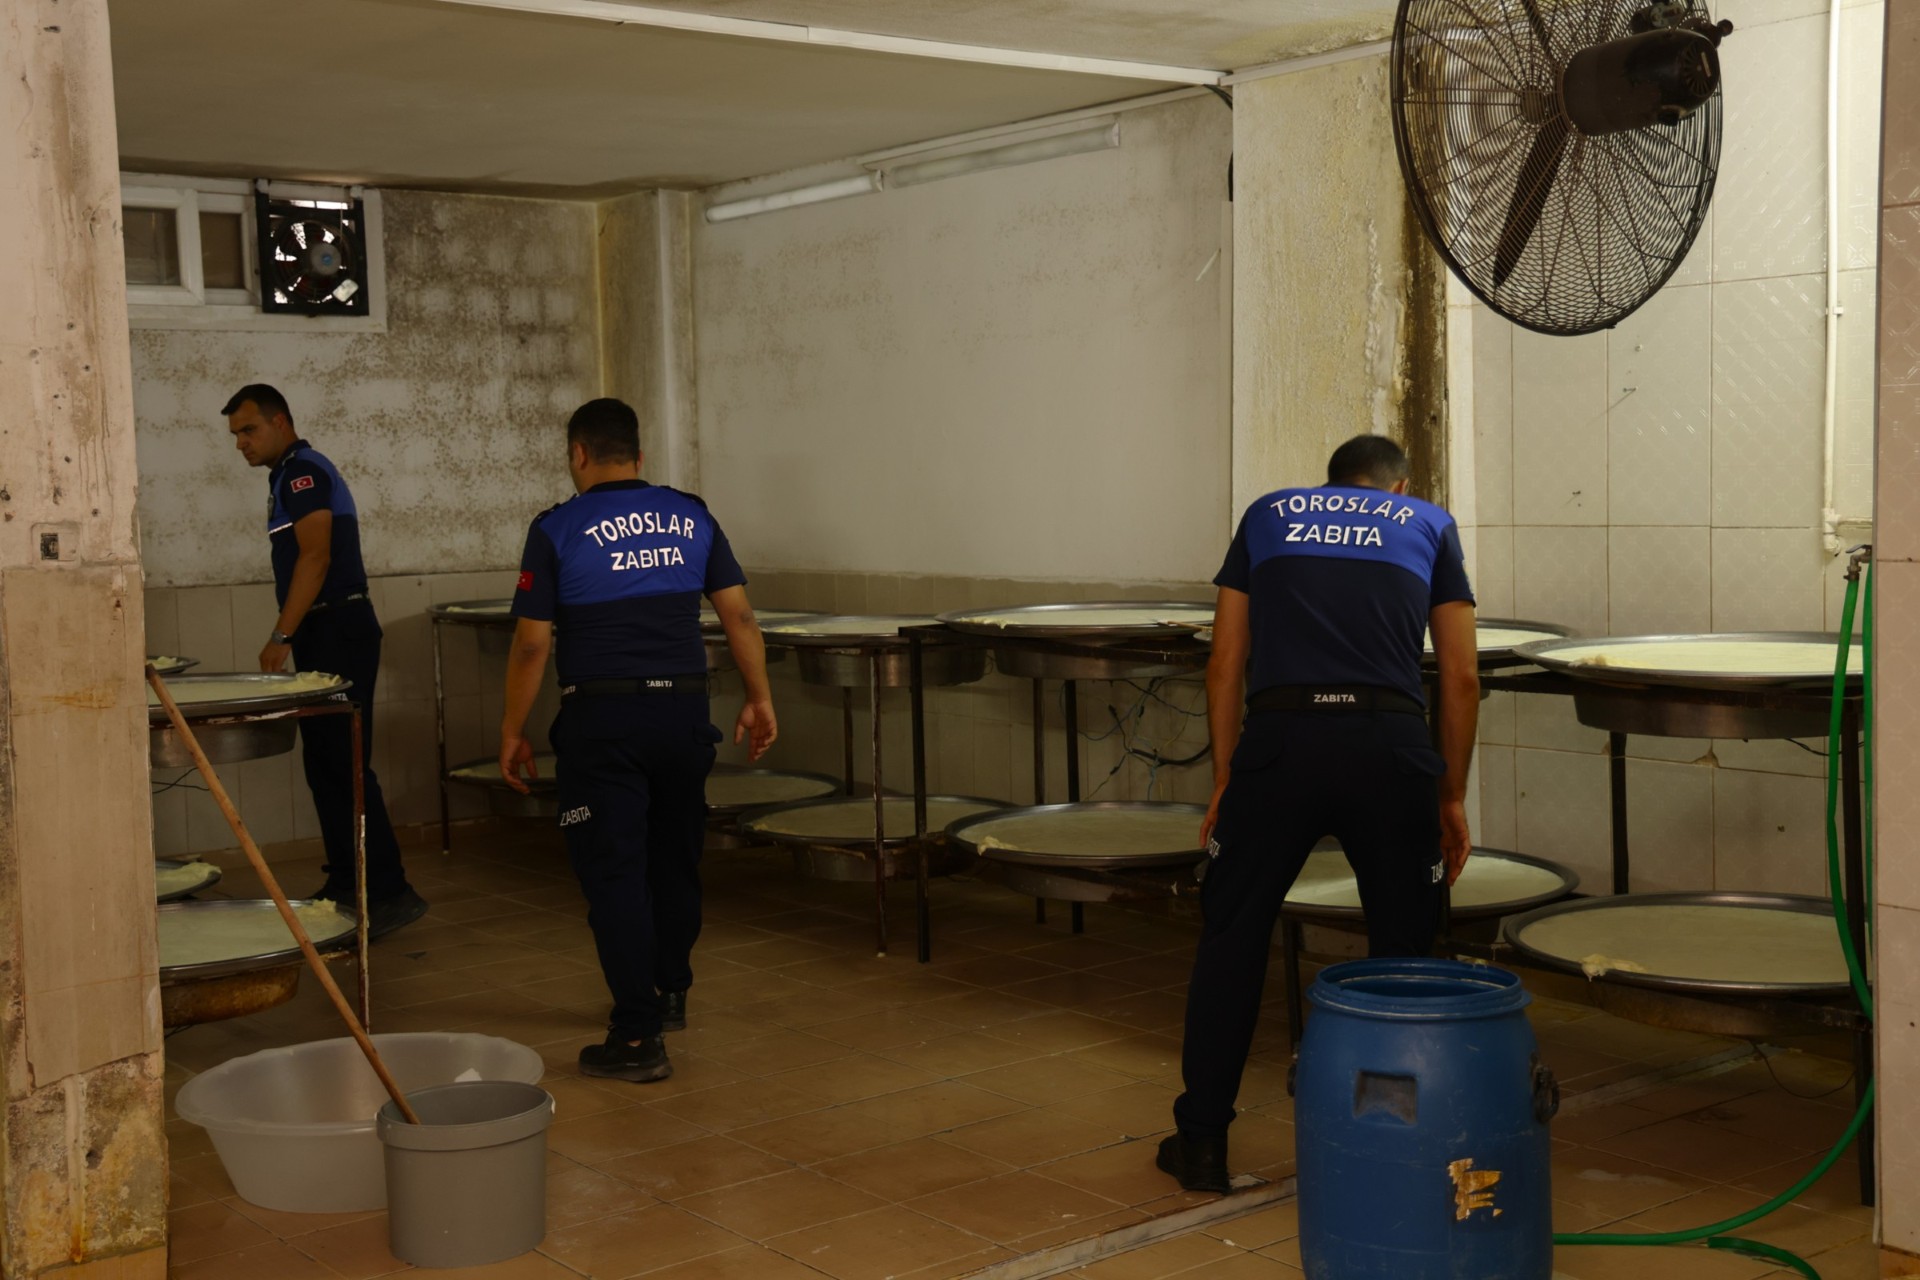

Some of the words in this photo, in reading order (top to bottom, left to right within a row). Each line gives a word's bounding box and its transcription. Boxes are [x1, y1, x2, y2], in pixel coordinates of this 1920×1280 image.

[1270, 494, 1414, 525] TOROSLAR
[584, 511, 695, 548] TOROSLAR
[1285, 523, 1382, 547] ZABITA
[610, 546, 685, 571] ZABITA
[1313, 693, 1356, 703] ZABITA
[559, 805, 592, 827] ZABITA
